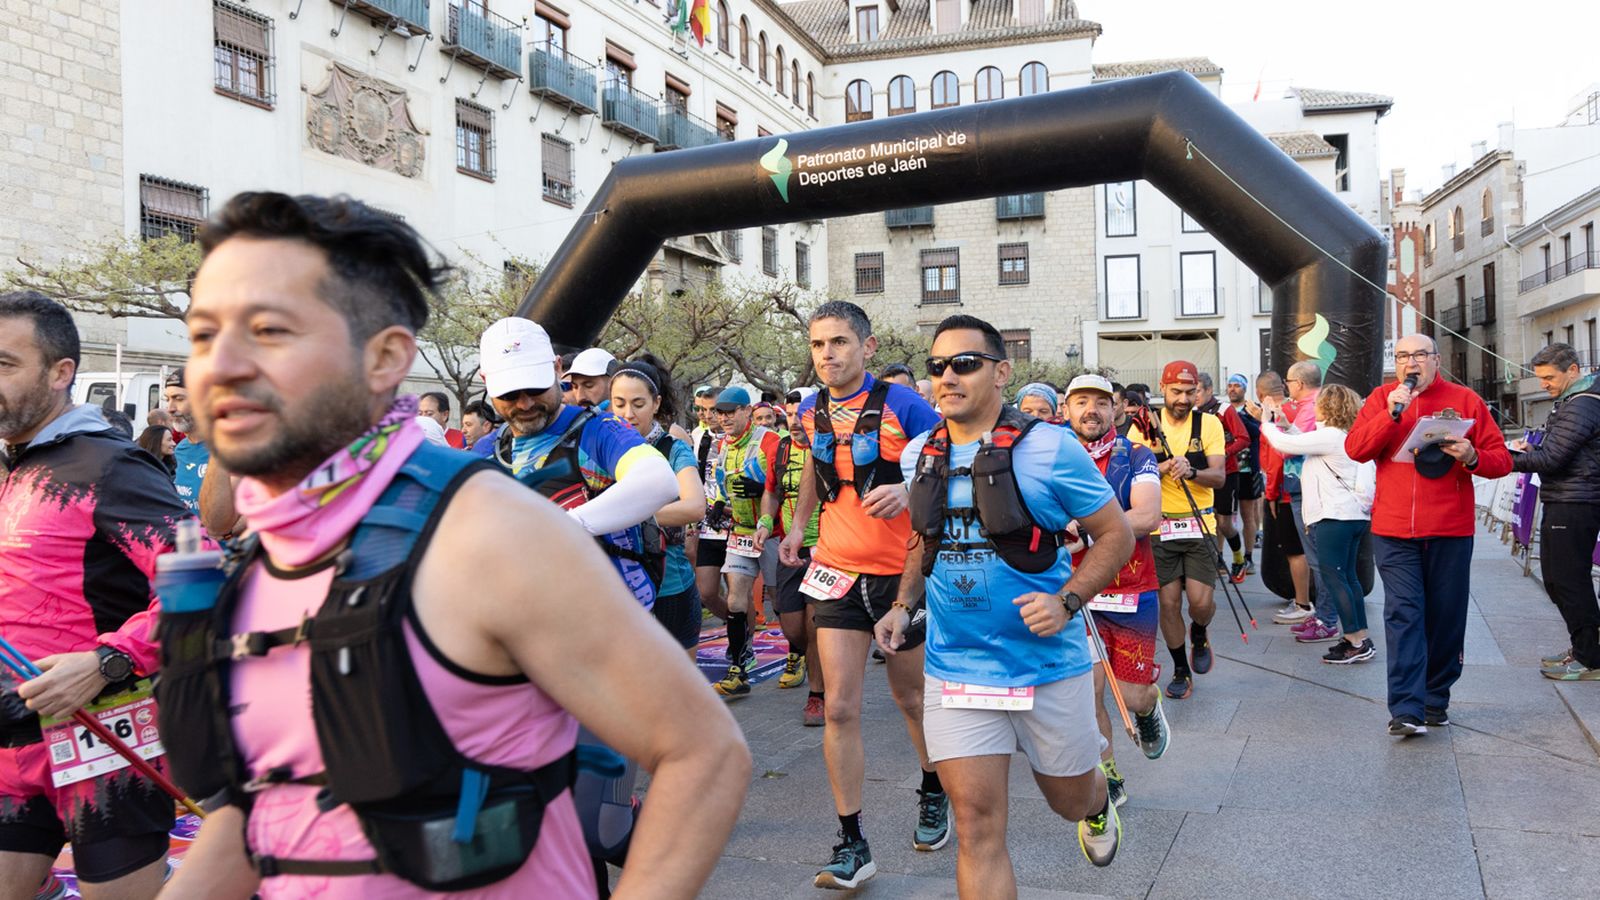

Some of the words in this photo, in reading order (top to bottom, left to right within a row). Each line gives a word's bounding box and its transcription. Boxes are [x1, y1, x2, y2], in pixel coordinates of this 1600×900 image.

[797, 146, 866, 169] Patronato
[870, 134, 942, 158] Municipal
[946, 131, 967, 146] de
[798, 163, 864, 187] Deportes
[867, 162, 887, 176] de
[890, 156, 928, 174] Jaén
[737, 538, 753, 548] 218
[814, 569, 837, 587] 186
